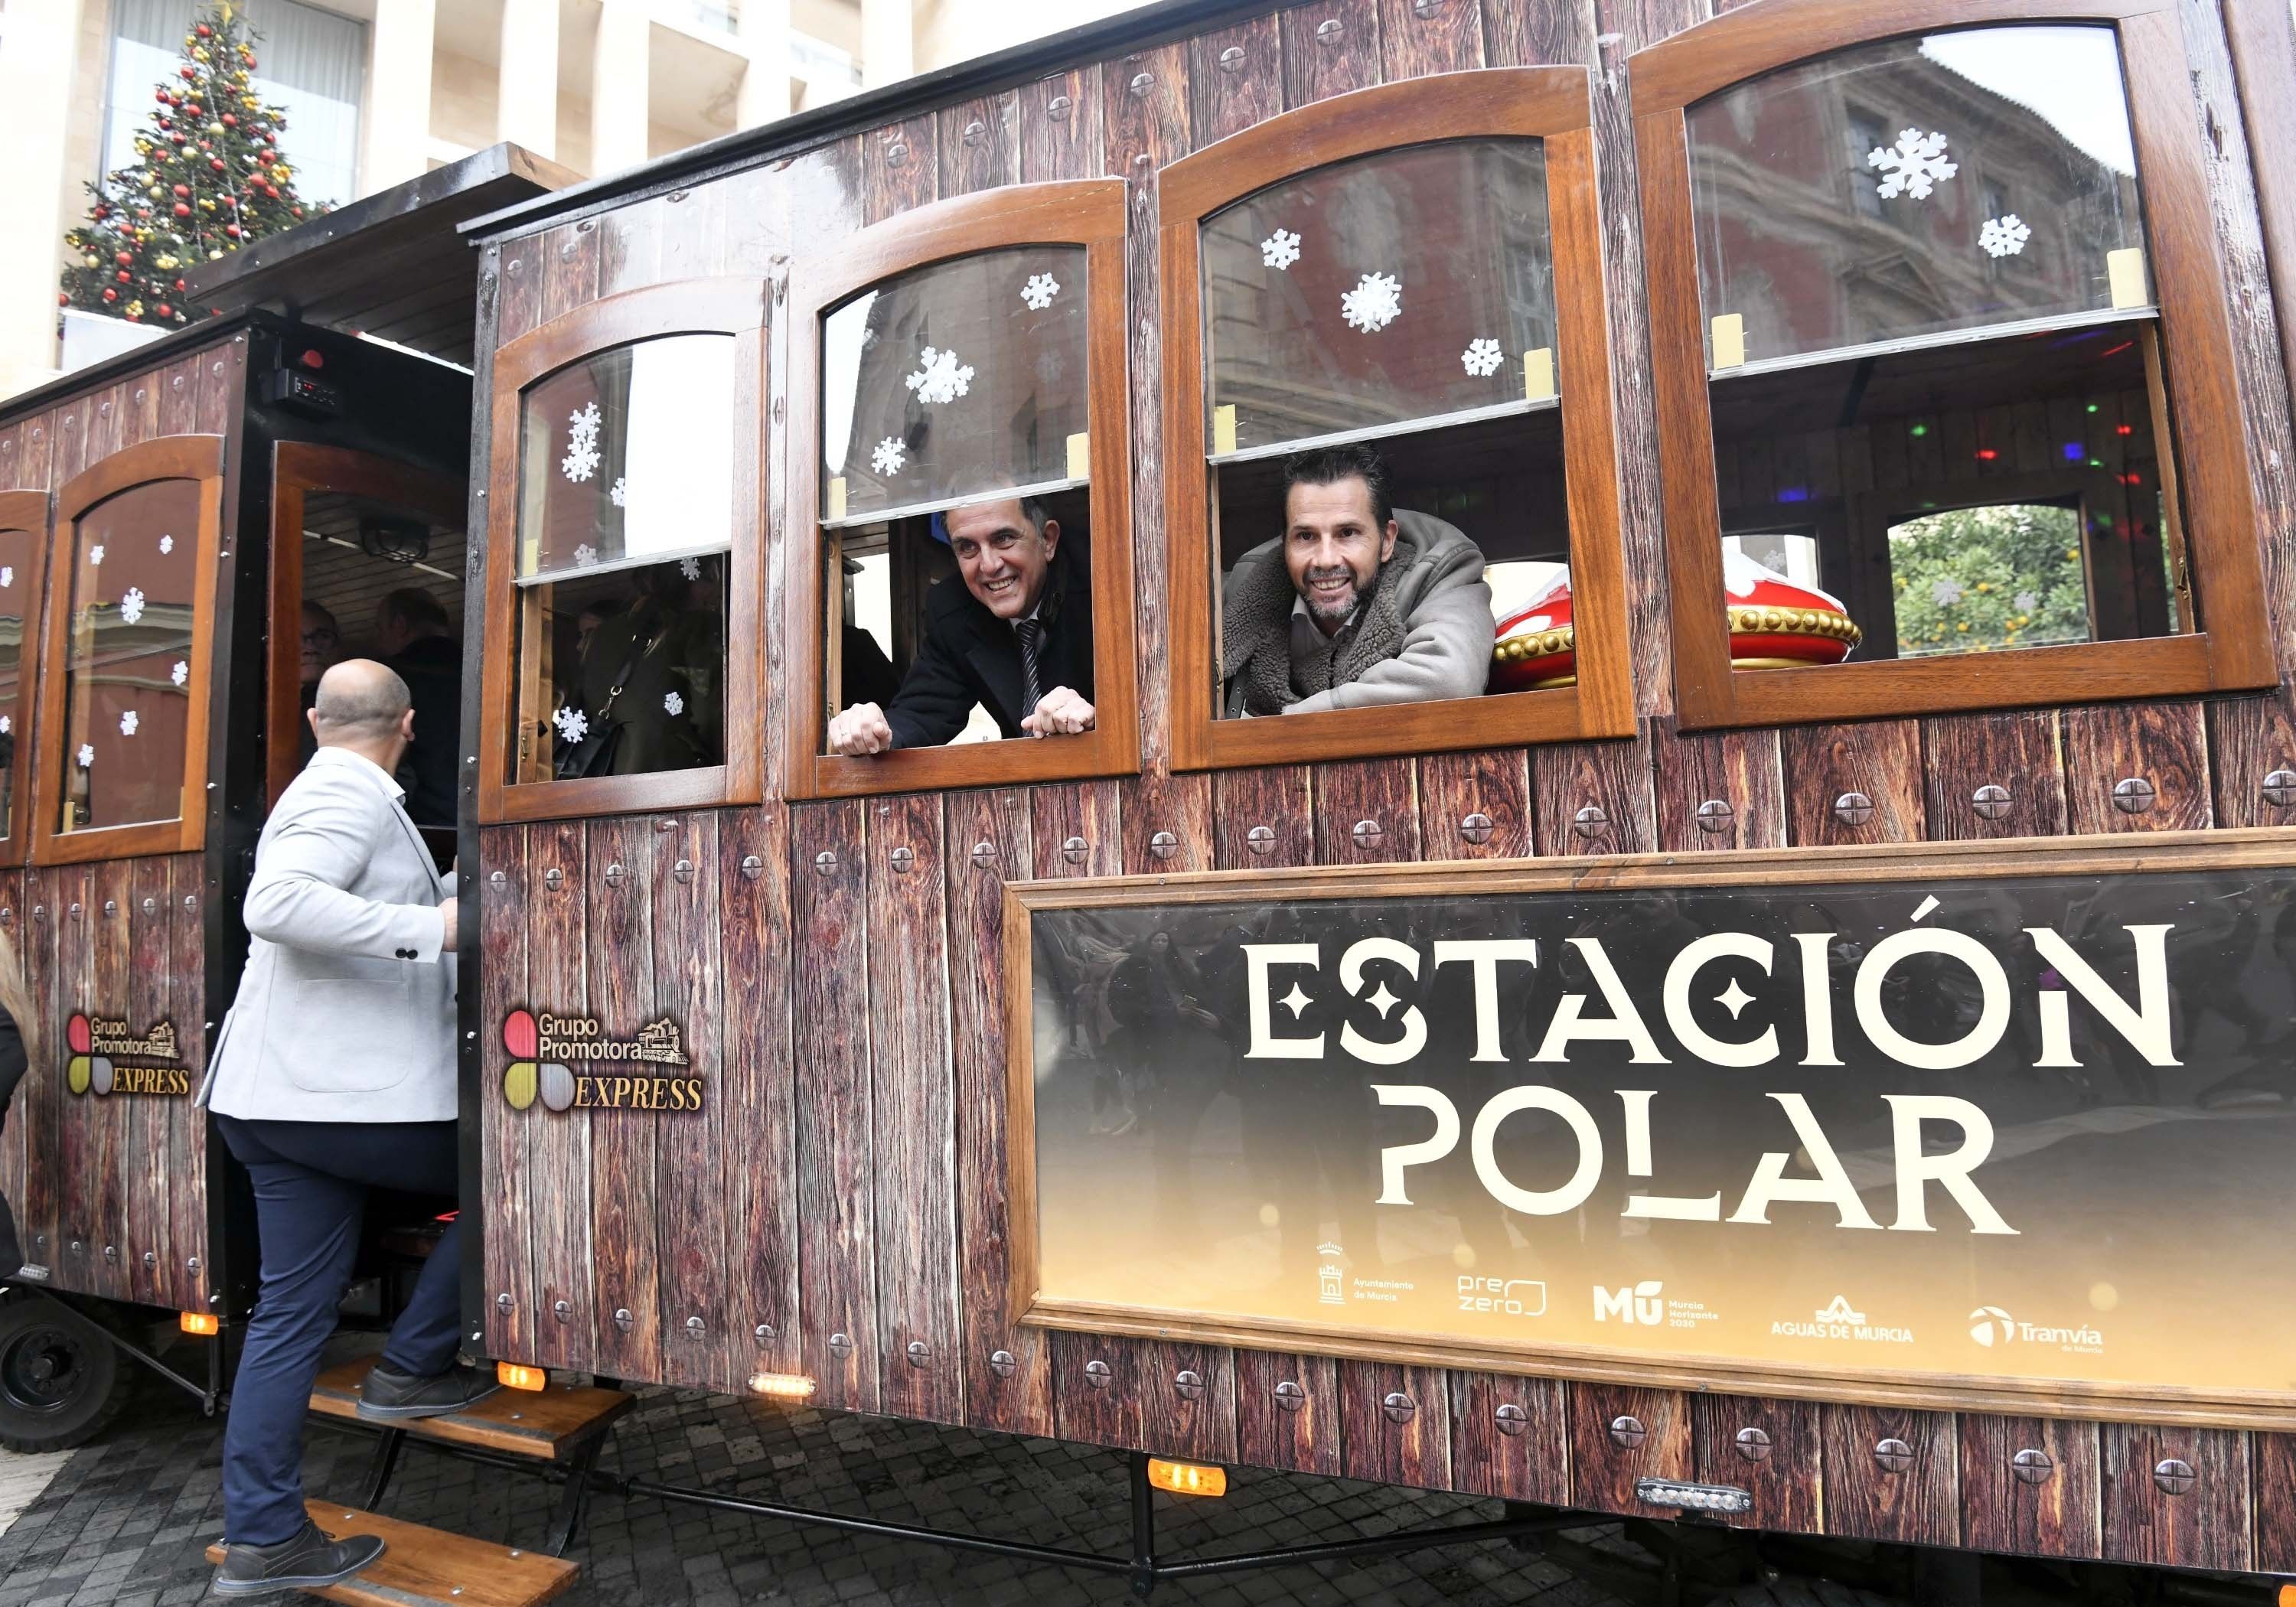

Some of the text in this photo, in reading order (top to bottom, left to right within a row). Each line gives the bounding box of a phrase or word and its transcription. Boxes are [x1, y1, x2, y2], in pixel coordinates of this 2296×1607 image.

[1239, 895, 2184, 1070] ESTACIÓN
[91, 1018, 126, 1036] Grupo
[540, 1013, 598, 1040] Grupo
[92, 1038, 152, 1055] Promotora
[540, 1037, 642, 1060] Promotora
[113, 1068, 188, 1094] EXPRESS
[575, 1076, 702, 1110] EXPRESS
[1370, 1084, 2021, 1234] POLAR
[1353, 1277, 1414, 1290] Ayuntamiento
[1457, 1275, 1503, 1293] pre
[1353, 1290, 1397, 1302] de Murcia
[1458, 1296, 1522, 1315] zero
[1668, 1300, 1704, 1311] Murcia
[1669, 1309, 1719, 1320] Horizonte
[1669, 1319, 1695, 1328] 2030
[1771, 1322, 1914, 1343] AGUAS DE MURCIA
[2017, 1322, 2103, 1345] Tranvía
